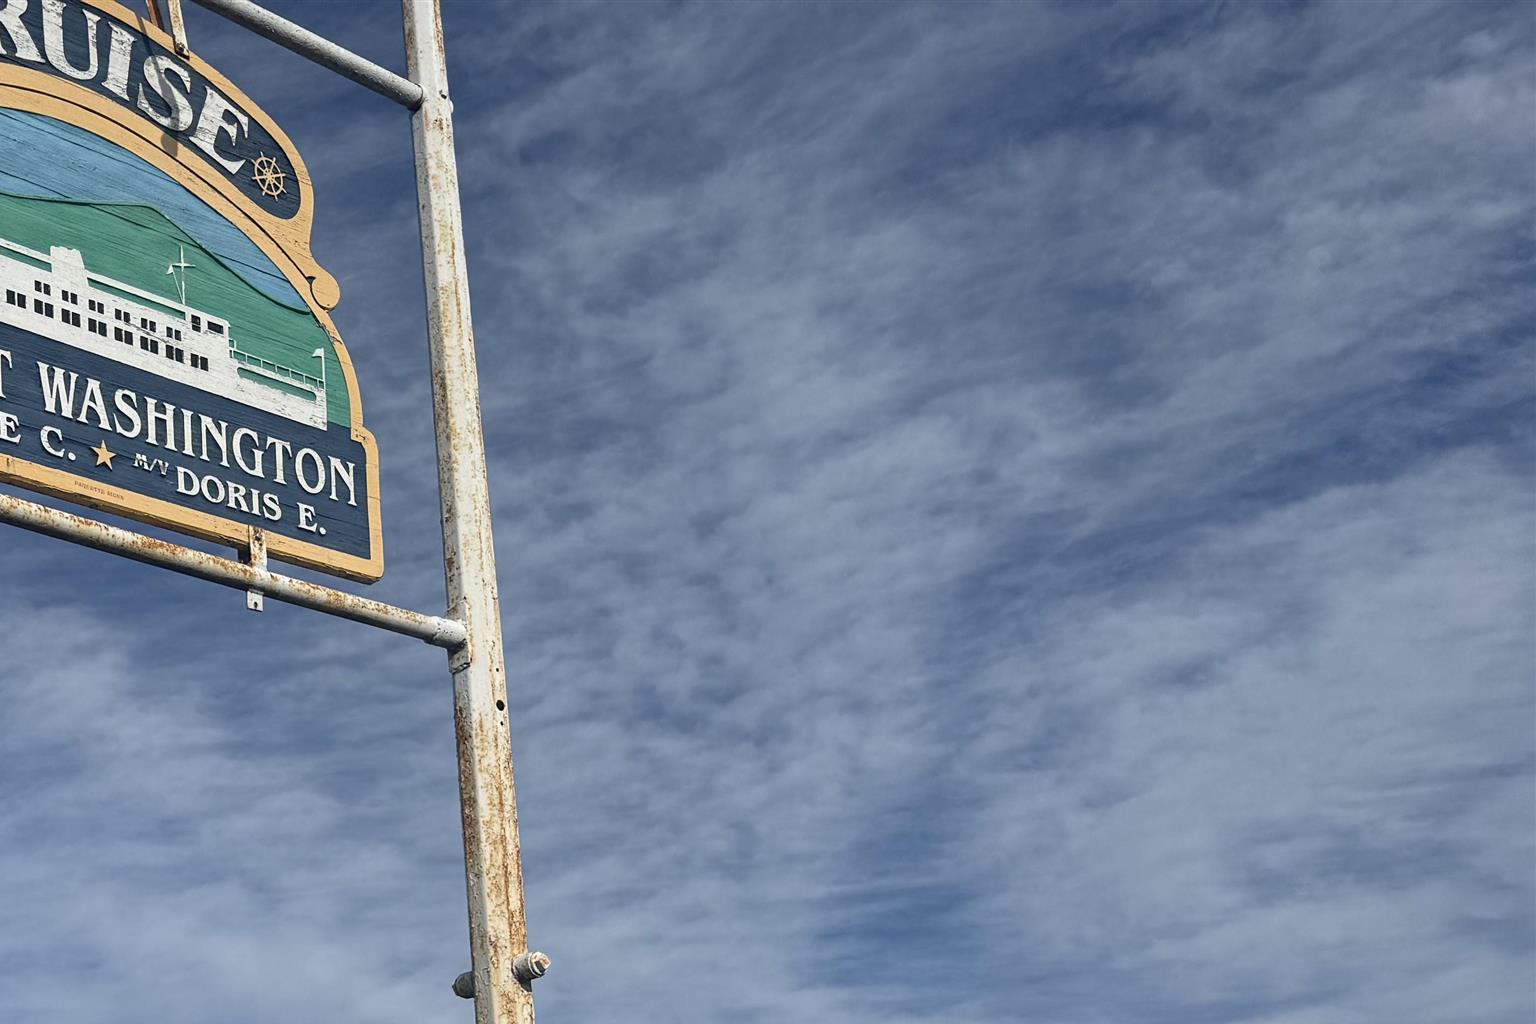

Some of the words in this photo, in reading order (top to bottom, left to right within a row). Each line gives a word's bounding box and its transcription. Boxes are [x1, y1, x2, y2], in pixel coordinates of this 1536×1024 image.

[36, 361, 358, 507] WASHINGTON
[40, 425, 77, 461] C.
[132, 452, 169, 476] M/V
[175, 465, 283, 522] DORIS
[296, 502, 327, 536] E.
